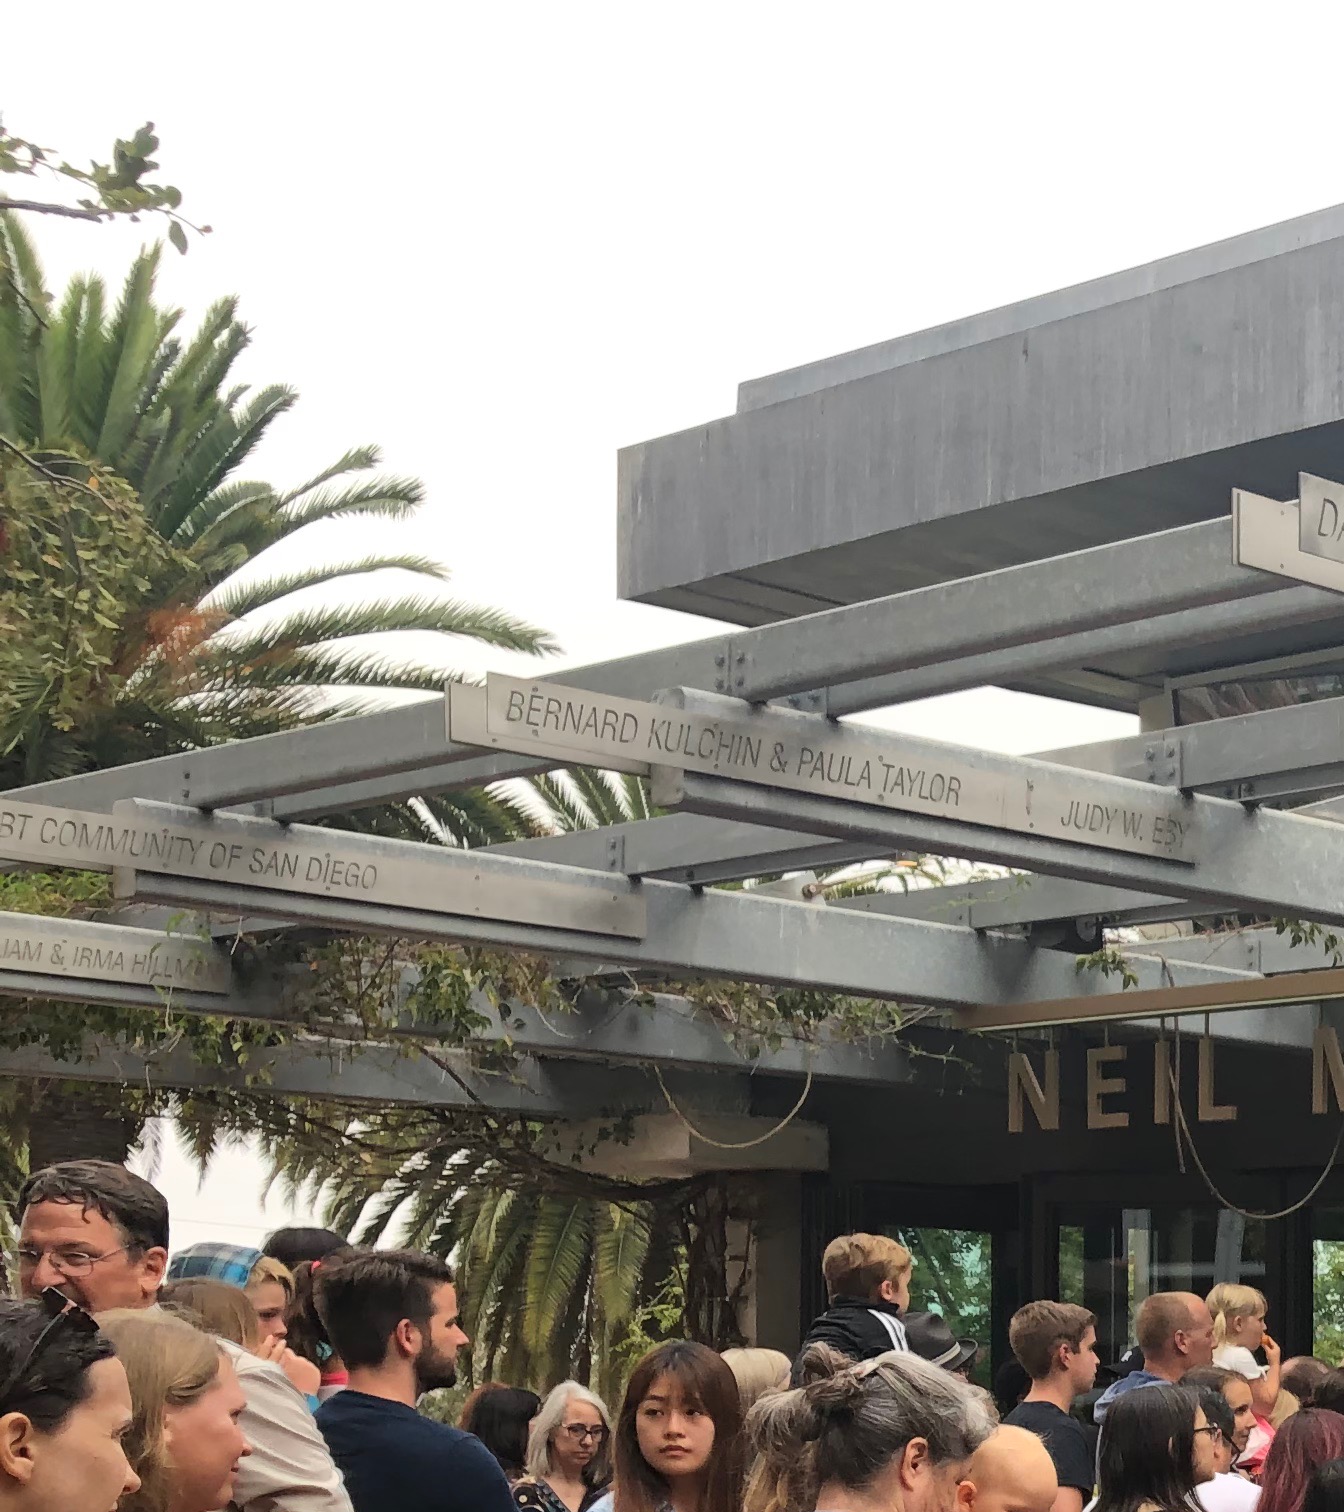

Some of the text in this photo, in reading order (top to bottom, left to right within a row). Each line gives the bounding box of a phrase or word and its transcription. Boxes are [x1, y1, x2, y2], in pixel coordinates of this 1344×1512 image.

[505, 689, 962, 807] BERNARD KULCHIN & PAULA TAYLOR
[40, 817, 203, 866] COMMUNITY
[209, 842, 243, 870] OF
[249, 847, 300, 879] SAN
[305, 854, 378, 890] DIEGO
[1060, 800, 1191, 849] JUDY W. EBY
[50, 943, 65, 965] &
[72, 946, 125, 973] IRMA
[1007, 1035, 1237, 1133] NEIL
